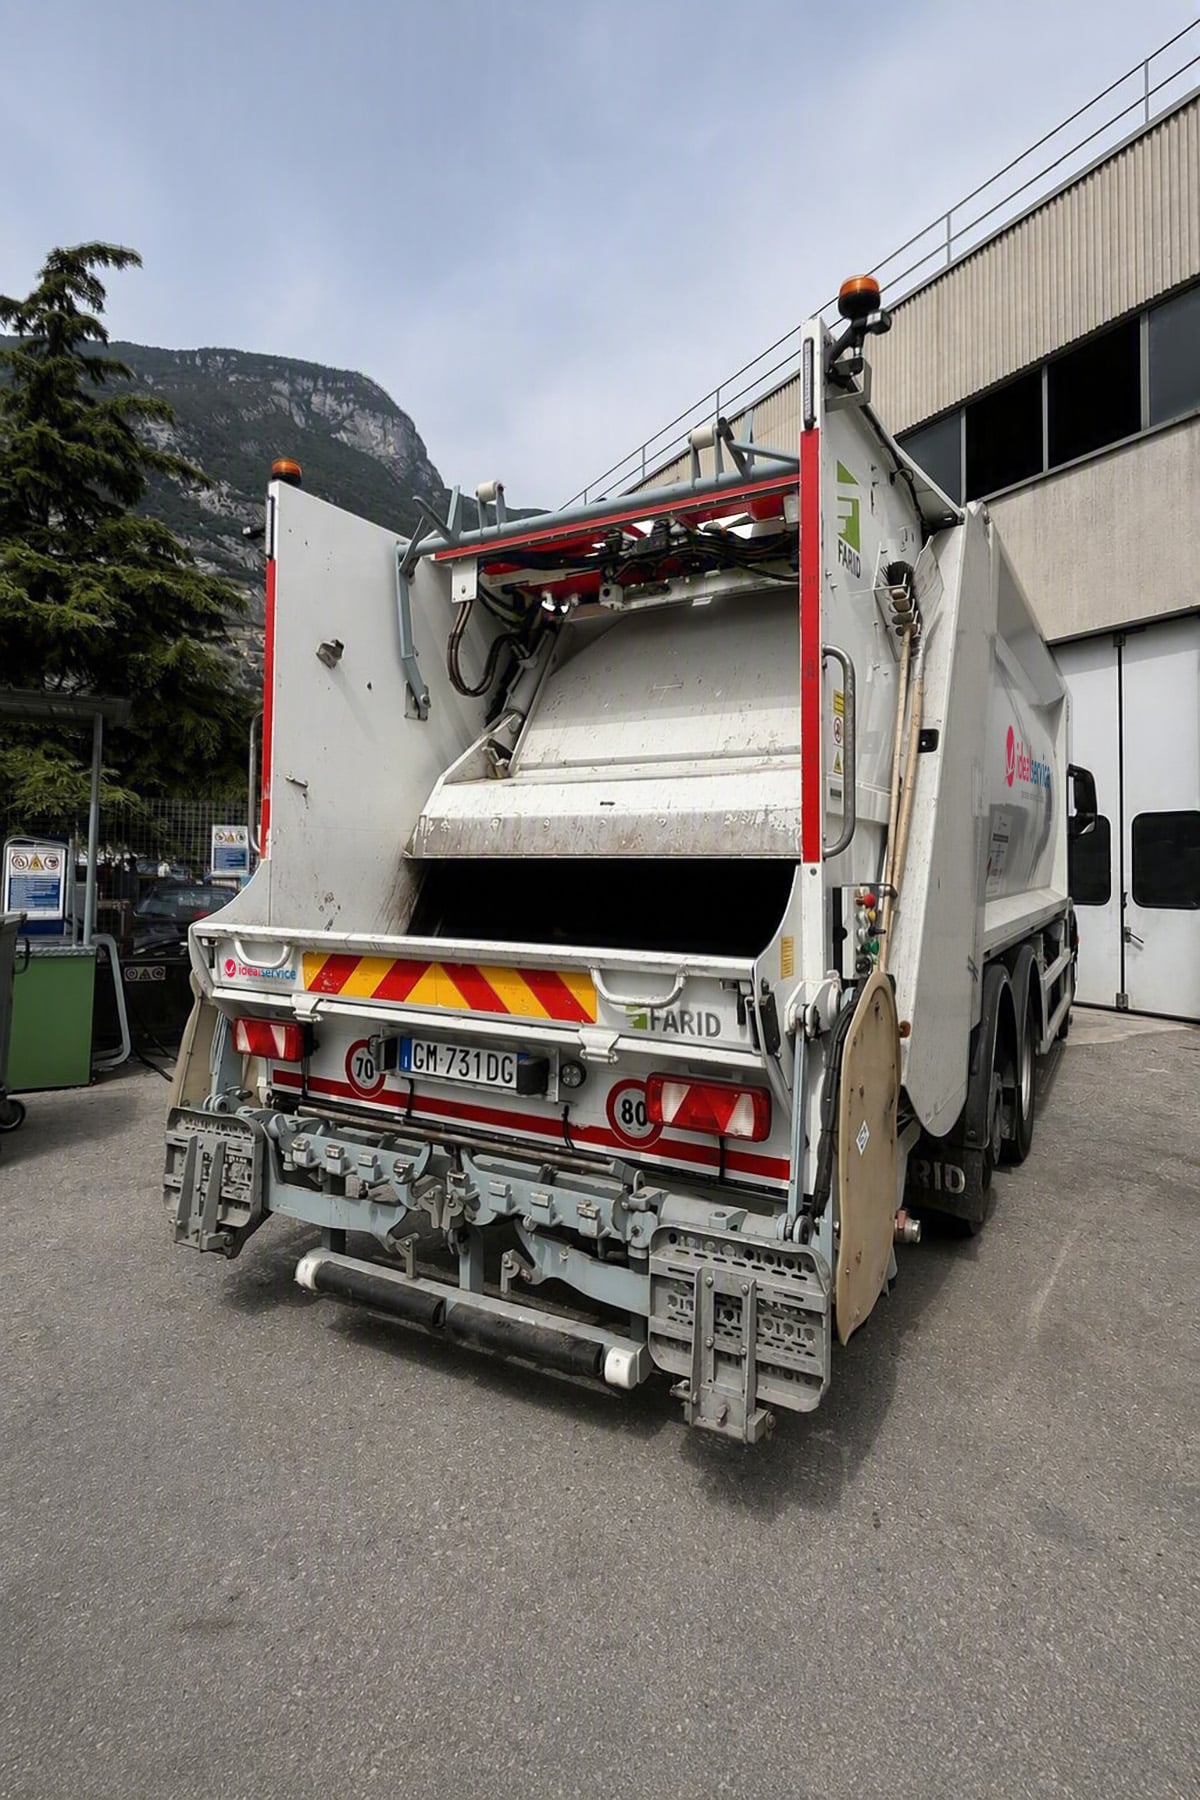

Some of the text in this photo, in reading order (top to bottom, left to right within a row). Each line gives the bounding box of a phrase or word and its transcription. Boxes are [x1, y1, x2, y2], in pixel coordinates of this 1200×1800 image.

[837, 538, 861, 579] FARID
[650, 1007, 722, 1038] FARID
[356, 1056, 375, 1080] 70
[621, 1098, 648, 1127] 80
